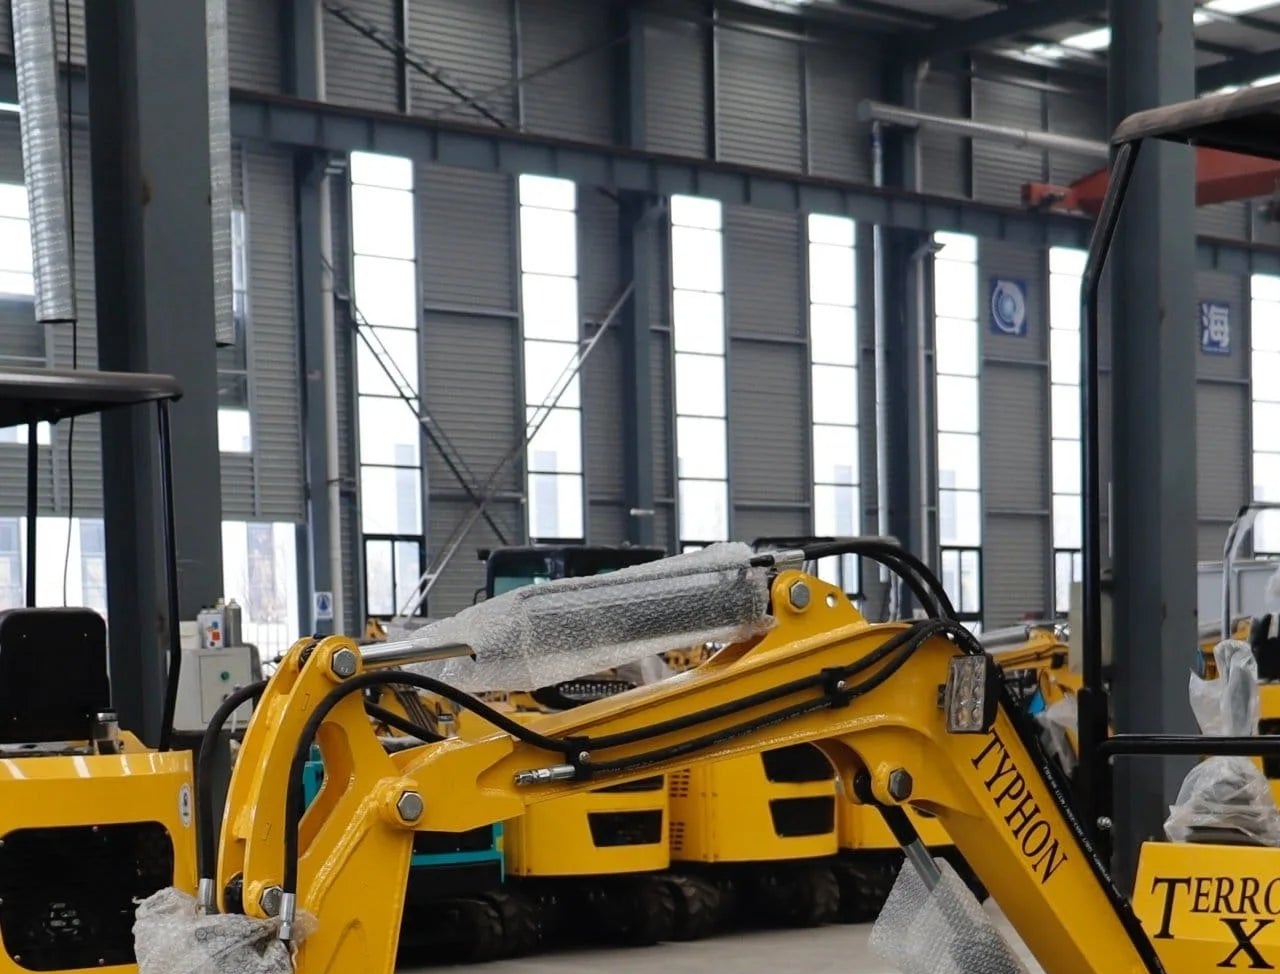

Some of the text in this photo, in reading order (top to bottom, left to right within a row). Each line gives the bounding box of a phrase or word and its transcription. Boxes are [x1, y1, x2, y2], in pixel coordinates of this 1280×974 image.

[1202, 303, 1230, 348] 海
[971, 726, 1068, 885] TYPHON
[1216, 918, 1275, 969] X
